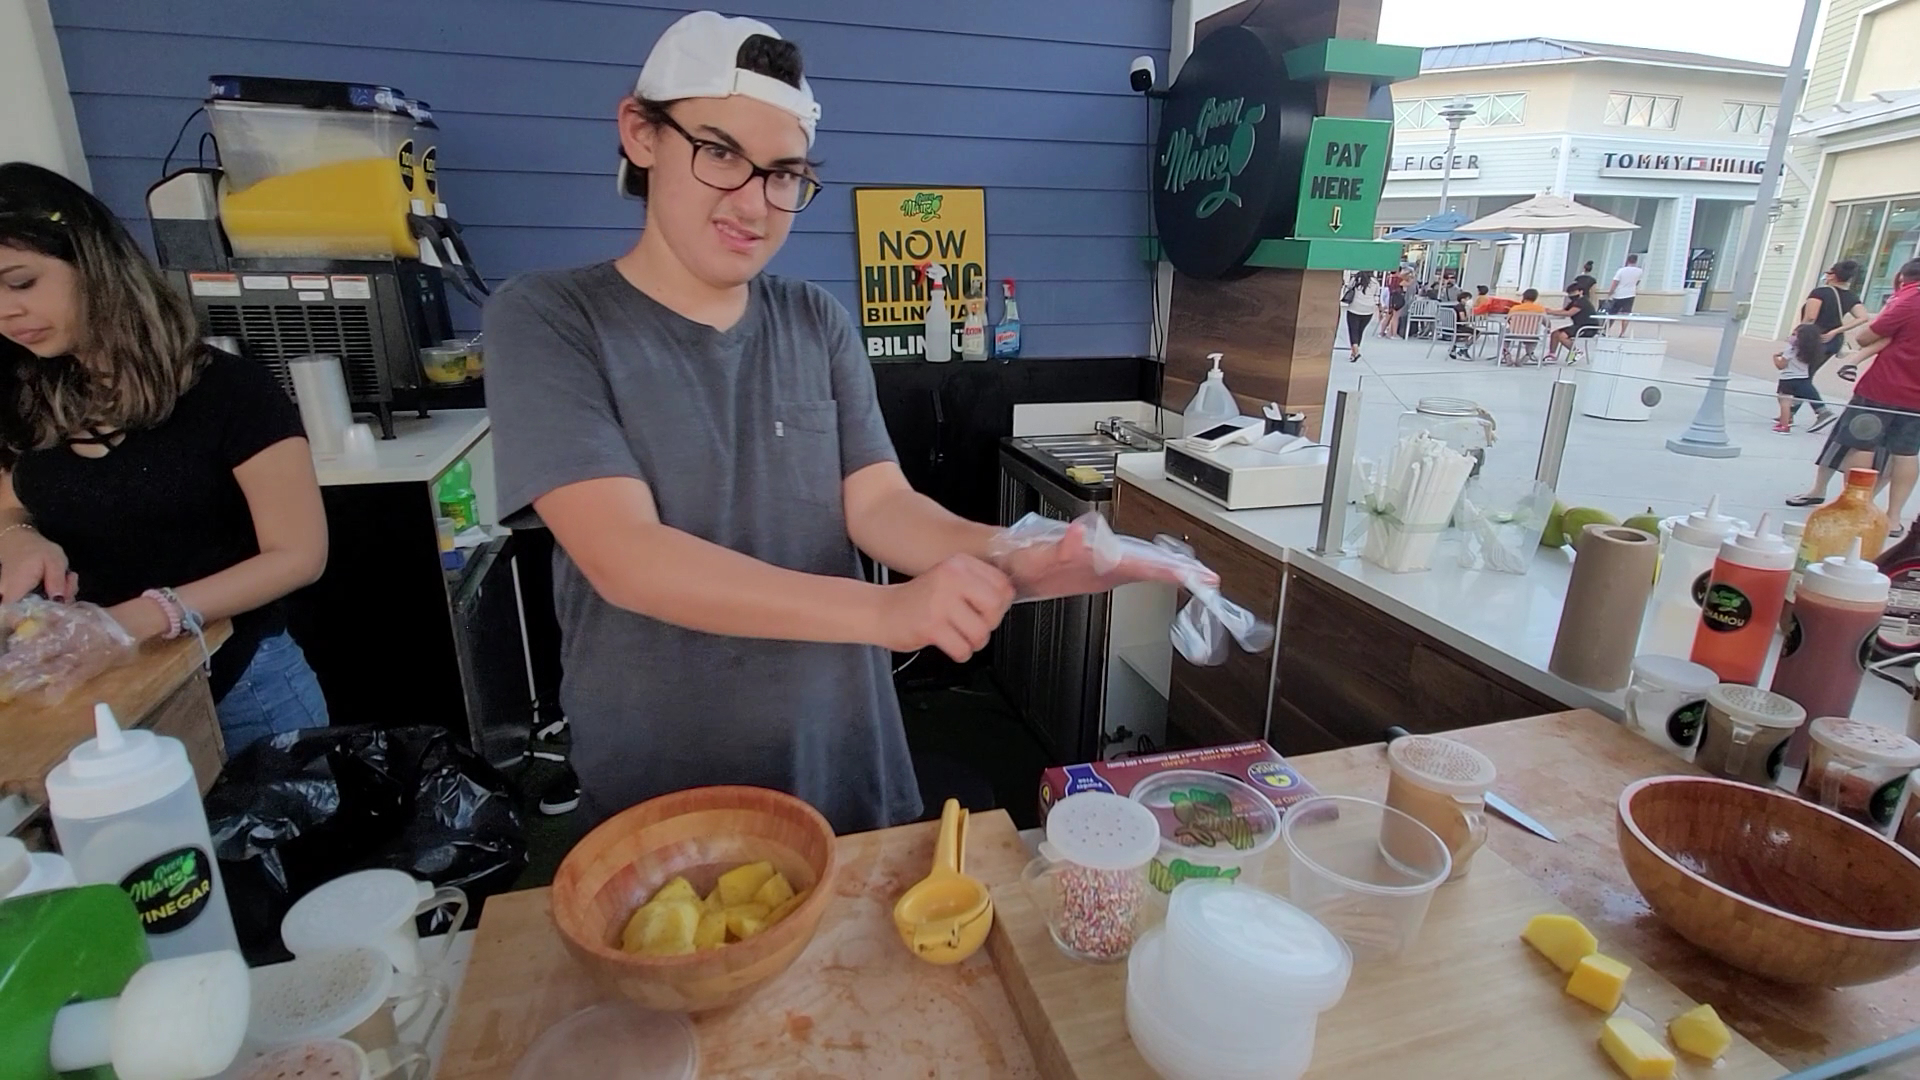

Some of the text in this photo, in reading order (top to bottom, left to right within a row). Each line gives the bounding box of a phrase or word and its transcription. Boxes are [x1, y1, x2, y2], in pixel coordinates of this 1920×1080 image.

[1196, 97, 1244, 146] Green
[1325, 141, 1368, 168] PAY
[1604, 152, 1684, 171] TOMMY
[1161, 122, 1255, 218] Mango
[1311, 175, 1364, 200] HERE
[879, 229, 967, 261] NOW
[867, 328, 964, 356] BILINÜ
